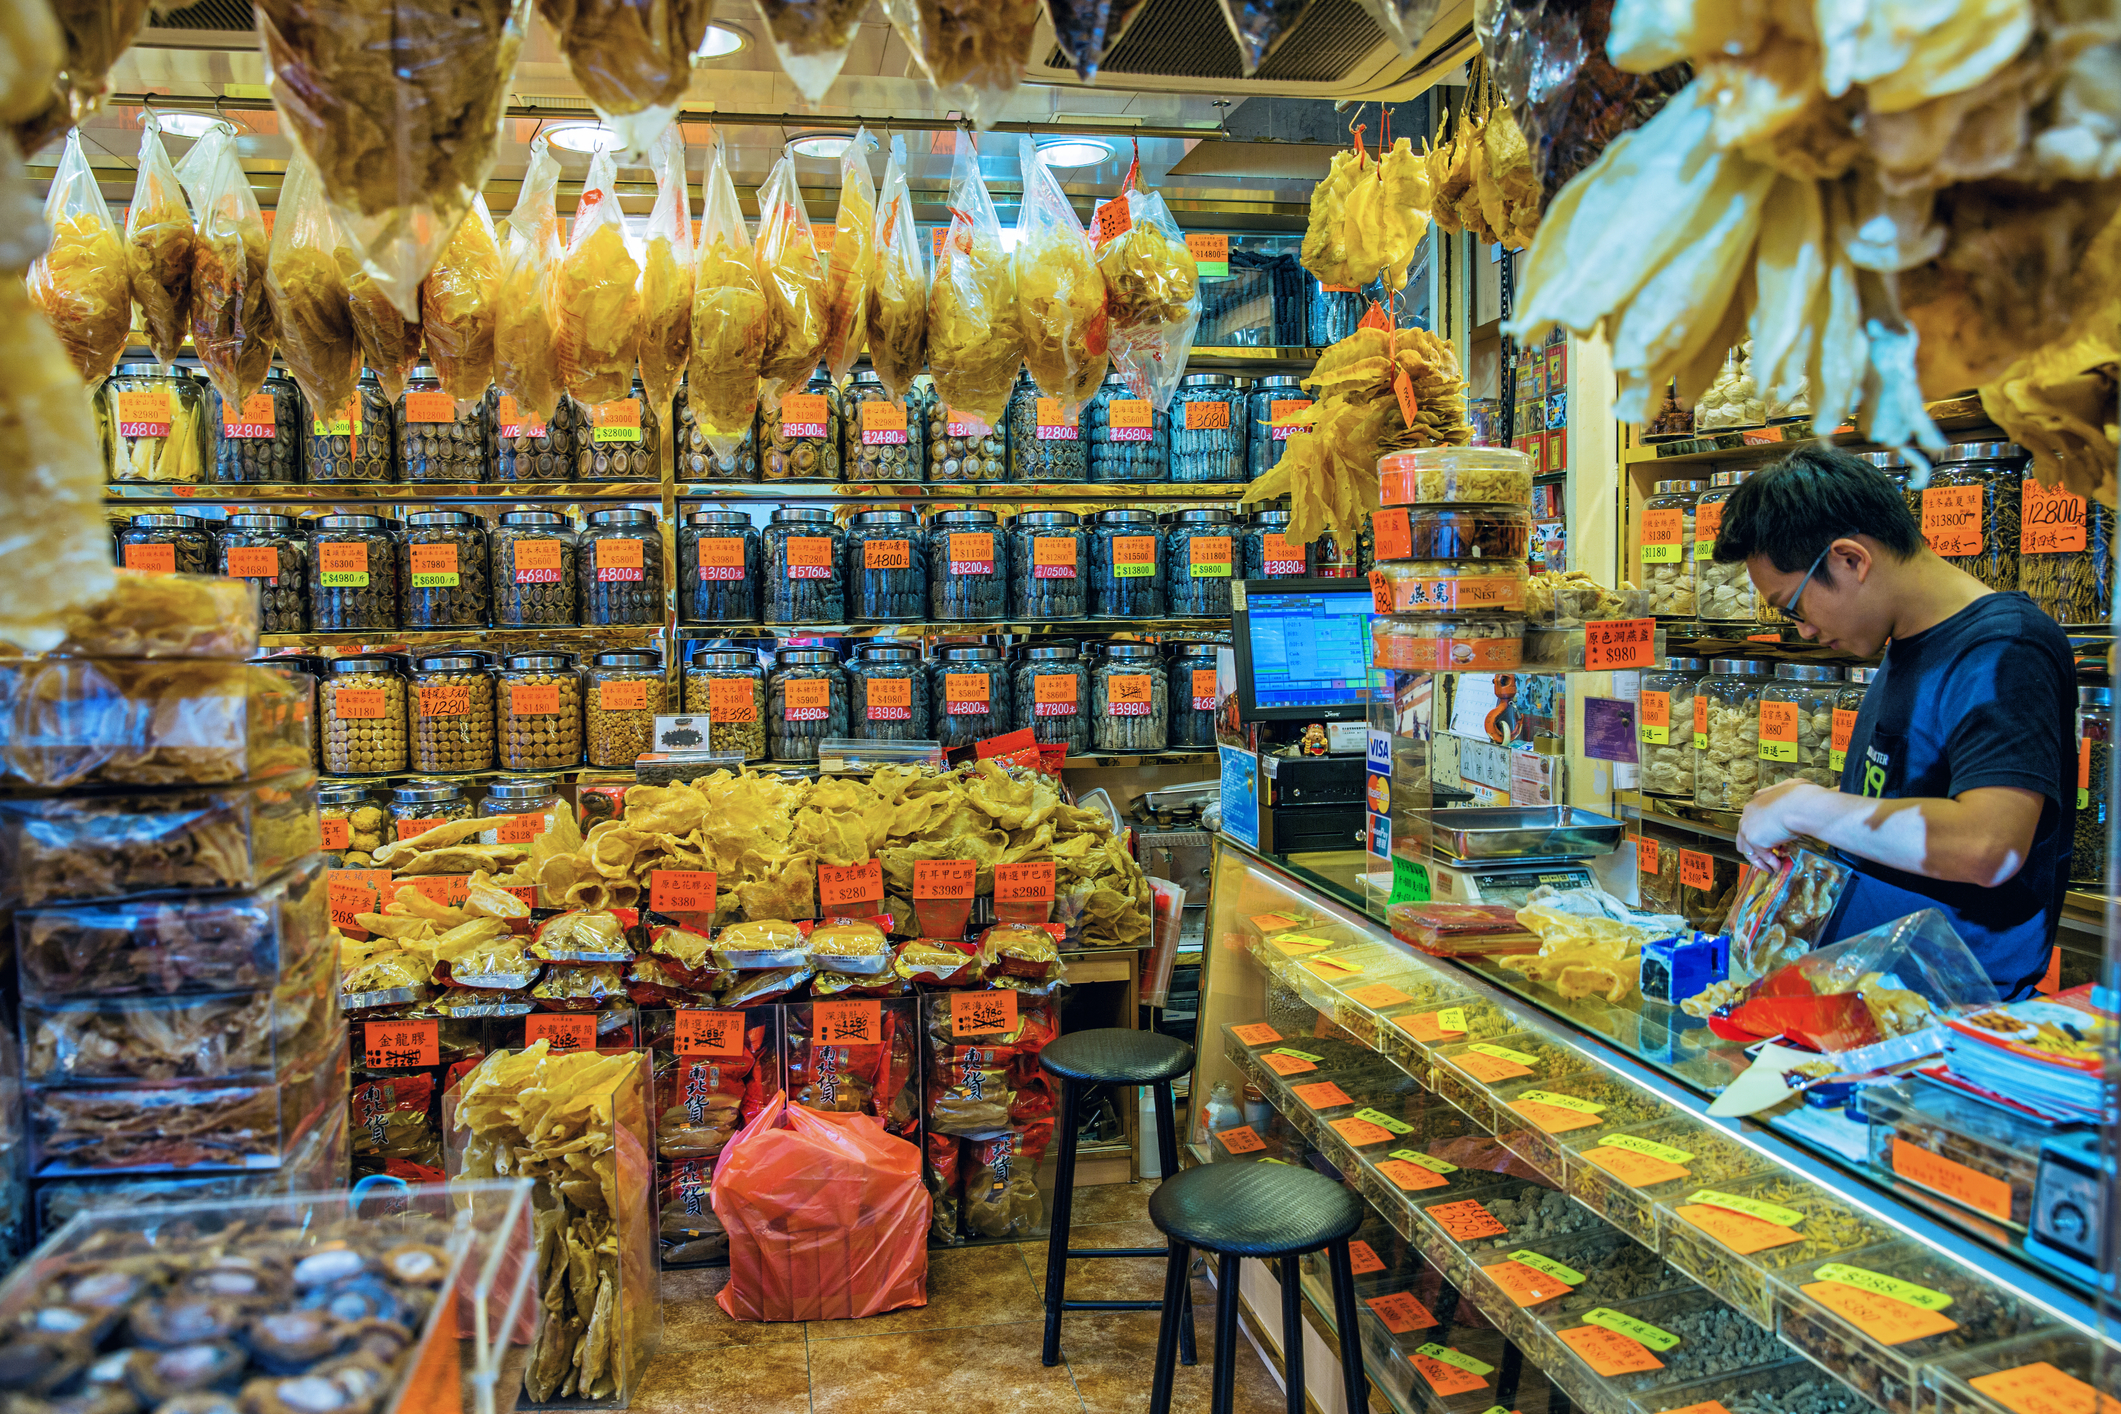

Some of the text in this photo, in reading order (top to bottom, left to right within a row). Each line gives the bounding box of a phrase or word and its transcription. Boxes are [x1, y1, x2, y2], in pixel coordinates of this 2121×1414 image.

[133, 410, 159, 419] $2980
[796, 411, 822, 420] $12800
[874, 418, 897, 426] $2980
[122, 423, 168, 436] 2680元
[227, 425, 274, 437] 3280元
[603, 429, 632, 437] $28000
[791, 425, 825, 436] 9500元
[1045, 427, 1077, 439] 2800元
[1118, 429, 1152, 440] 4680元
[871, 431, 906, 443] 2480元
[2028, 498, 2086, 525] 12800元
[1931, 513, 1966, 526] $13800
[1649, 531, 1671, 540] $1380
[960, 549, 990, 558] $11500
[1124, 552, 1148, 560] $15500
[1201, 552, 1226, 560] $11800
[1277, 549, 1297, 557] $4880
[1645, 547, 1666, 557] $1180
[330, 560, 354, 568] $6300
[528, 557, 552, 565] $5600
[611, 556, 633, 564] $5800
[799, 555, 823, 563] $7280
[874, 554, 908, 566] 4800元
[240, 566, 267, 574] $4680
[798, 566, 830, 577] 5760元
[959, 562, 990, 573] 9200元
[1043, 566, 1074, 576] 10500元
[1123, 566, 1149, 574] $13800
[1271, 561, 1304, 573] 3880元
[516, 569, 559, 582] 4680元
[599, 568, 641, 581] 4800元
[708, 567, 743, 579] 3180元
[1474, 591, 1496, 600] NEST
[1606, 646, 1636, 663] $980
[723, 695, 744, 703] $480
[877, 695, 902, 704] $4980
[1046, 691, 1067, 699] $8600
[431, 700, 469, 715] 1280元
[523, 703, 550, 712] $1480
[614, 698, 632, 706] $530
[954, 702, 988, 713] 4800元
[347, 707, 375, 716] $1180
[793, 708, 829, 719] 4880元
[874, 707, 910, 719] 3980元
[1045, 703, 1077, 715] 7800元
[1116, 703, 1151, 715] 3980元
[1370, 738, 1388, 759] VISA
[510, 831, 531, 840] $128
[1369, 821, 1388, 839] UnionPay
[839, 887, 866, 899] $280
[932, 886, 963, 895] $3980
[1013, 886, 1046, 897] $2980
[671, 897, 695, 906] $380
[379, 1032, 426, 1047] 金龍膠
[816, 1046, 840, 1104] 南北貨
[962, 1048, 986, 1101] 南北貨
[684, 1066, 709, 1124] 南北貨
[363, 1086, 389, 1144] 南北貨
